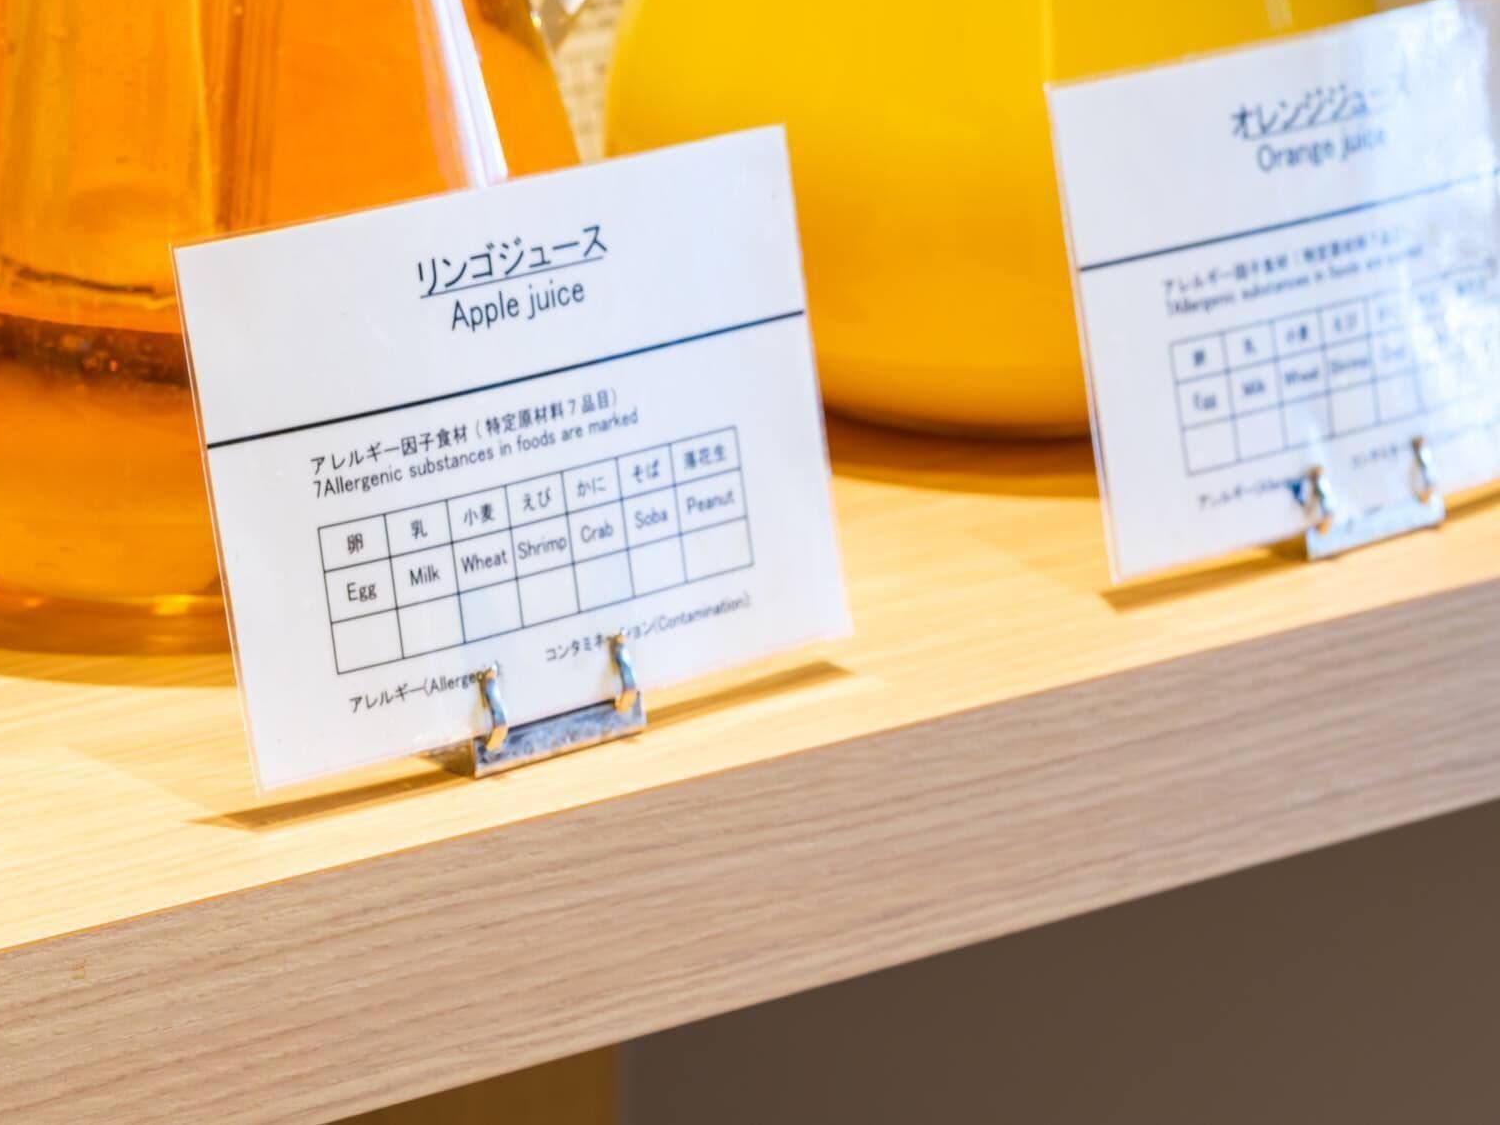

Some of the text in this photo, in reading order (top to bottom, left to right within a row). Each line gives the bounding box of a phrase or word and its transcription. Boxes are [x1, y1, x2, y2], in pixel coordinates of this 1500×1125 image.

[418, 224, 608, 296] リンゴジュース
[452, 280, 585, 332] Apple juice
[312, 408, 639, 499] 7Allergenic substances in foods are marked
[463, 502, 495, 526] 小麦
[523, 487, 551, 512] えび
[346, 489, 735, 602] Egg Milk Wheat Shrimp Crab Soba Peanut
